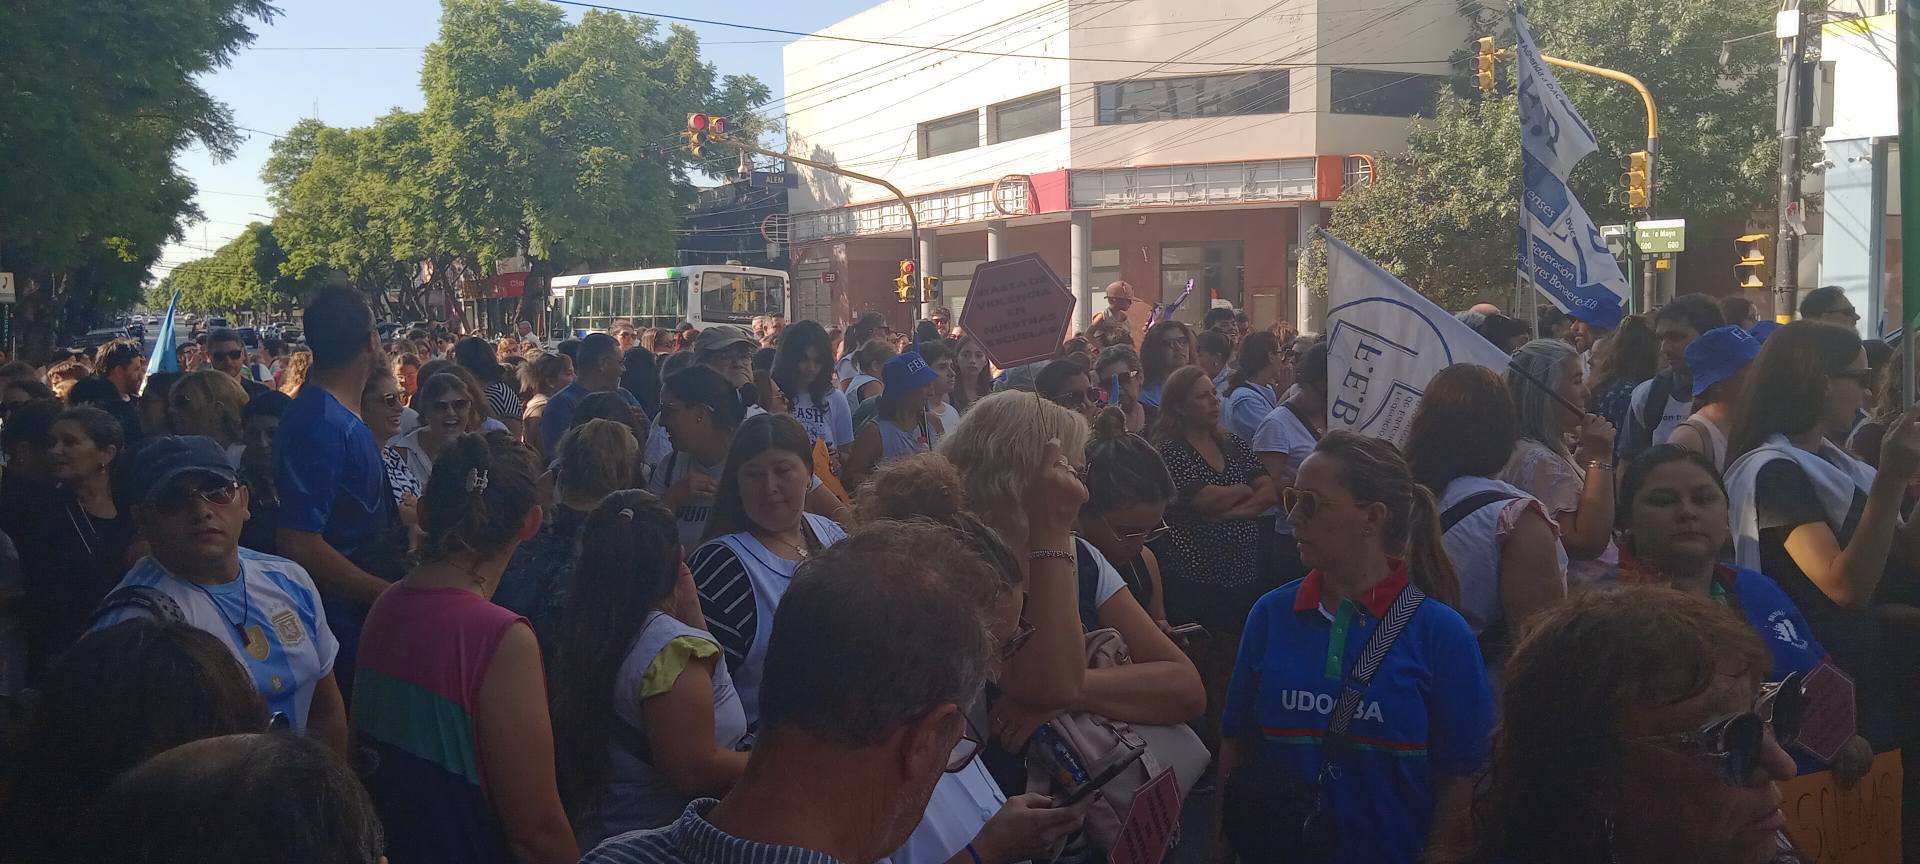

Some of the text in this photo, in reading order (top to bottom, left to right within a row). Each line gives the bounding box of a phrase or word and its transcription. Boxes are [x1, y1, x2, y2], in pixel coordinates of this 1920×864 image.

[766, 175, 784, 184] ALEM
[1660, 230, 1677, 238] Mayo
[1282, 689, 1384, 722] UDOBA
